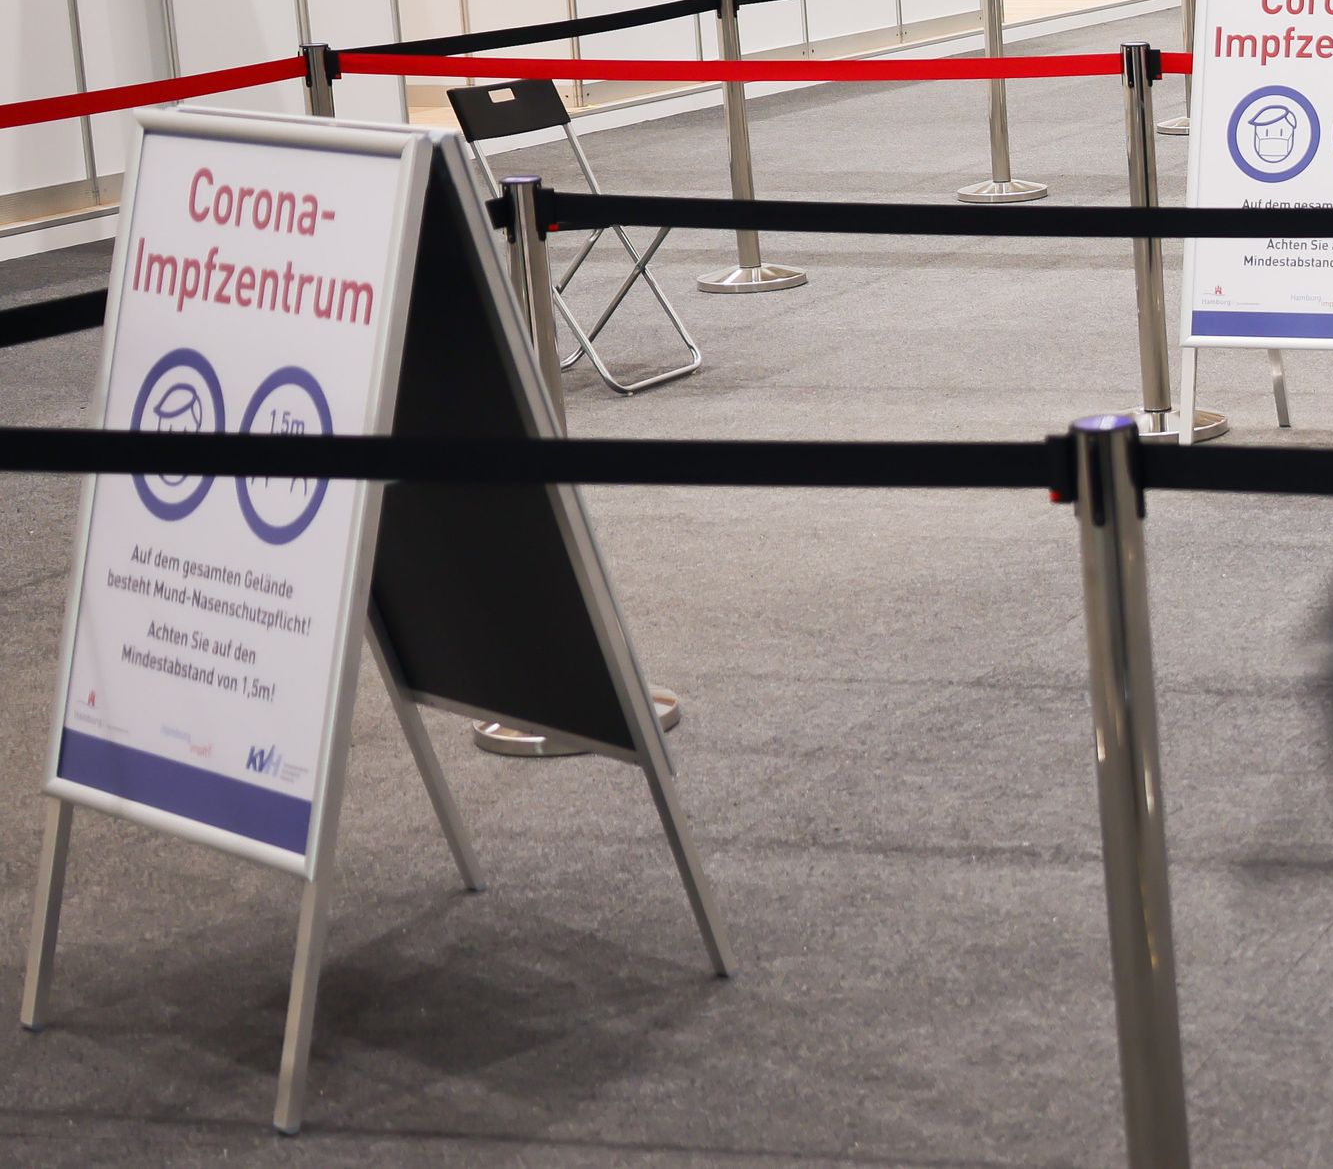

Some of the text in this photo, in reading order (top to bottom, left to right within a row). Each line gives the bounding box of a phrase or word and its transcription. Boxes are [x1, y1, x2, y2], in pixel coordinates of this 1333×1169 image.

[189, 168, 335, 236] Corona-
[1266, 239, 1308, 250] Achten
[1310, 240, 1329, 251] Sie
[132, 238, 374, 325] Impfzentrum
[270, 409, 305, 435] 15m
[131, 544, 294, 599] Auf dem gesamten Gelände
[107, 568, 312, 637] besteht Mund-Nasenschutzpflicht!
[148, 620, 257, 665] Achten Sie auf den
[121, 643, 277, 703] Mindestabstand von 1,5m!
